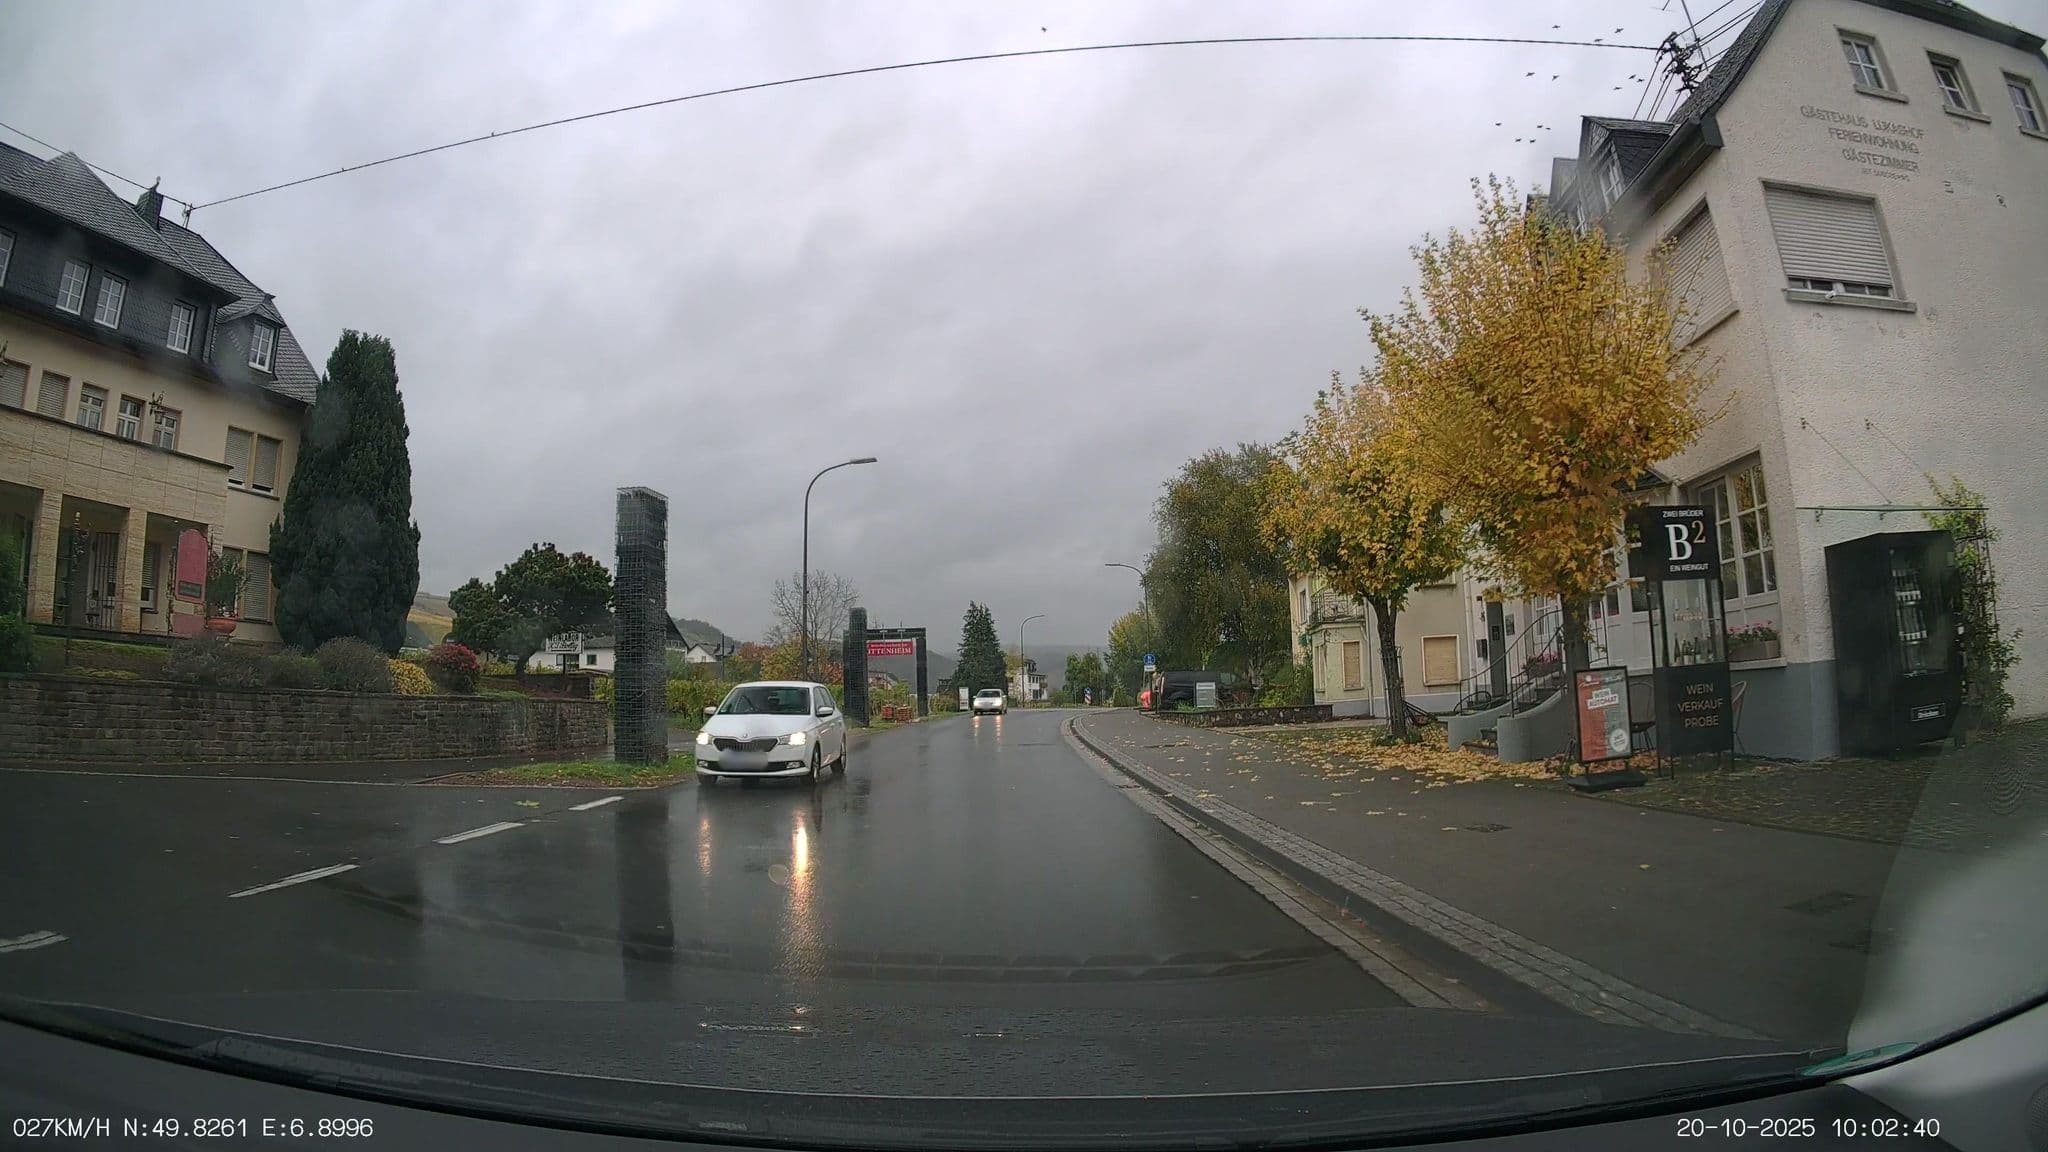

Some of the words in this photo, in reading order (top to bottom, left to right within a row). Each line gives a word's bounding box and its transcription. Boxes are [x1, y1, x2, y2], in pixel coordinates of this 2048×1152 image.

[1800, 105, 1869, 128] GÄSTEHAUS
[1828, 127, 1920, 154] FERIENWOHNUNG
[1842, 147, 1919, 172] GÄSTEZIMMER
[1662, 510, 1678, 518] ZWEI
[1679, 509, 1704, 517] BRÜDER
[1669, 564, 1681, 572] EIN
[1682, 563, 1709, 571] WEINGUT
[1686, 683, 1714, 695] WEIN
[1589, 695, 1617, 707] AUTOMAT
[1678, 698, 1723, 712] VERKAUF
[1684, 715, 1719, 729] PROBE
